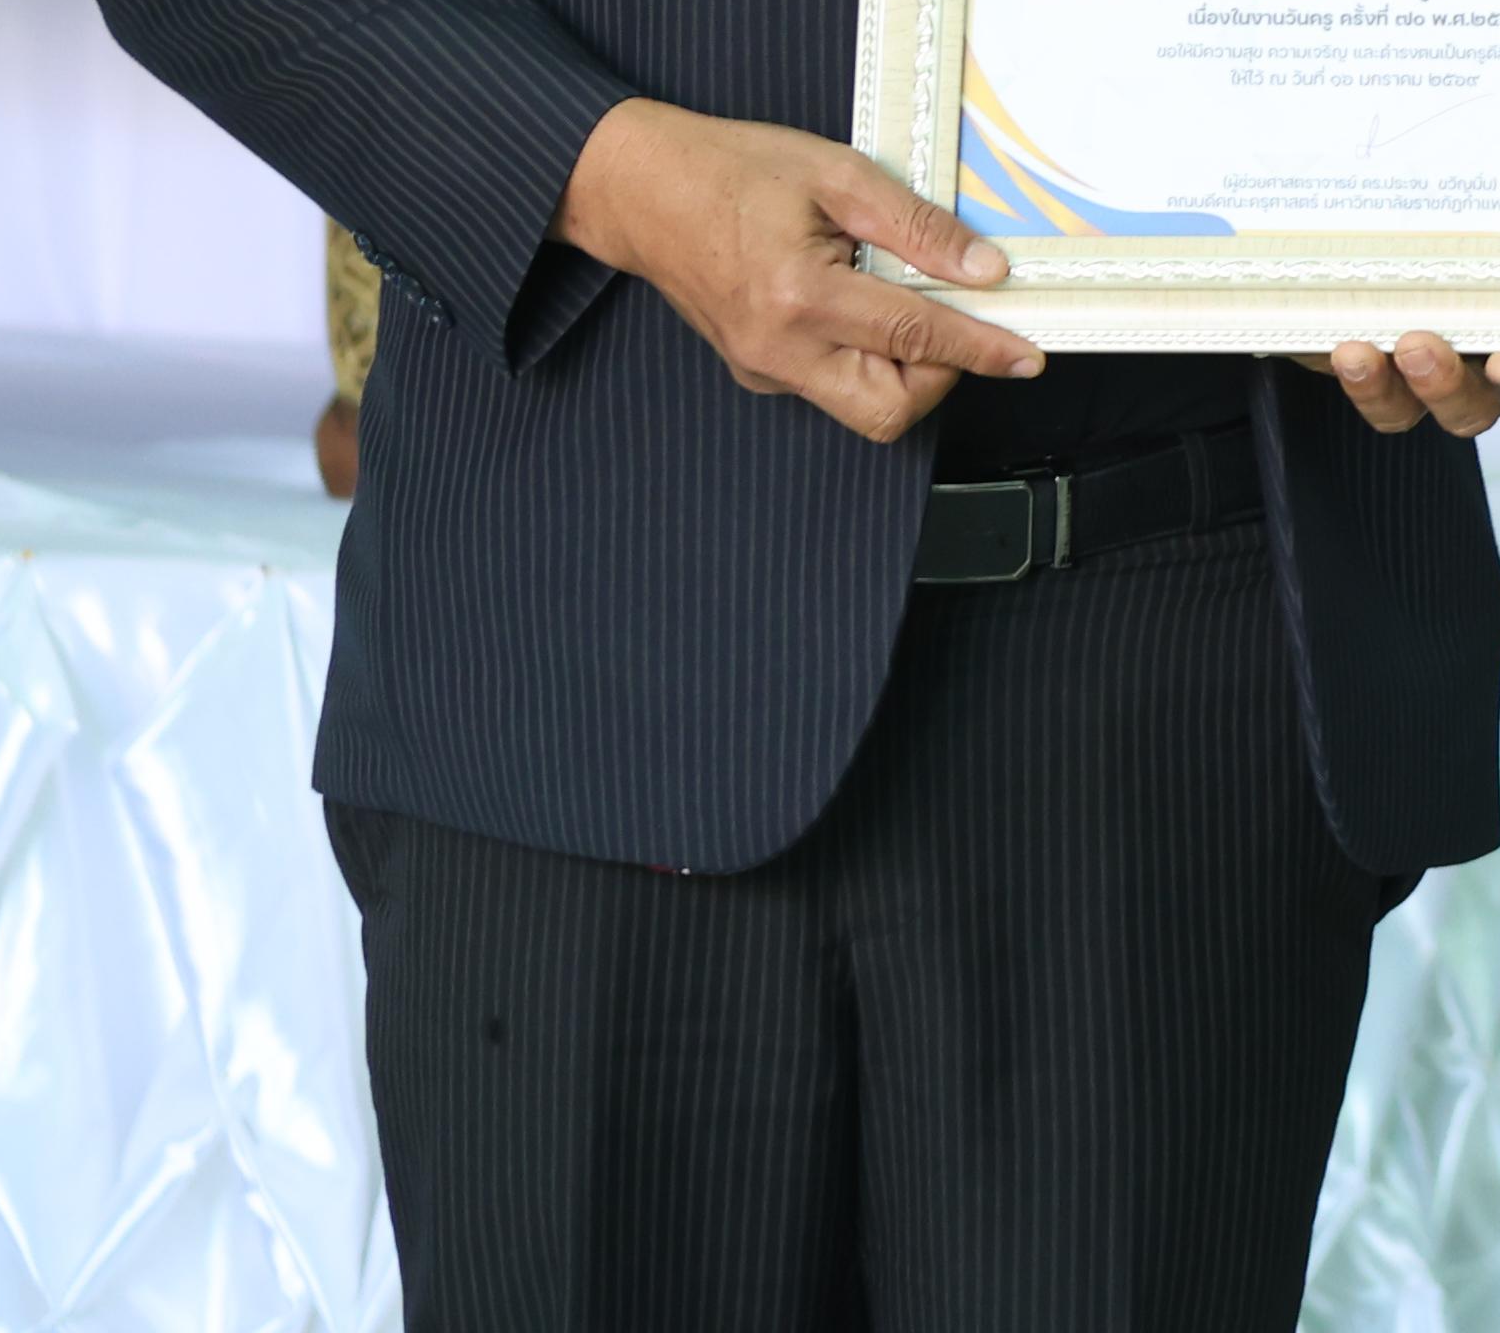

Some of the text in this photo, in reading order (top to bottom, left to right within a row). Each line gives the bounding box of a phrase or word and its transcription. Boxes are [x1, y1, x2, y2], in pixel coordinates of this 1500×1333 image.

[1187, 4, 1334, 32] เนื่องในงานวันครู
[1339, 3, 1390, 27] ครั้งที่
[1156, 41, 1264, 65] ขอให้มีความสุข
[1266, 44, 1349, 64] ความเจริญ
[1229, 68, 1265, 86] ให้ไว้
[1268, 72, 1288, 86] ณ
[1291, 64, 1327, 86] วันที่
[1358, 73, 1424, 87] มกราคม
[1165, 190, 1320, 215] คณบดีคณะครุศาสตร์
